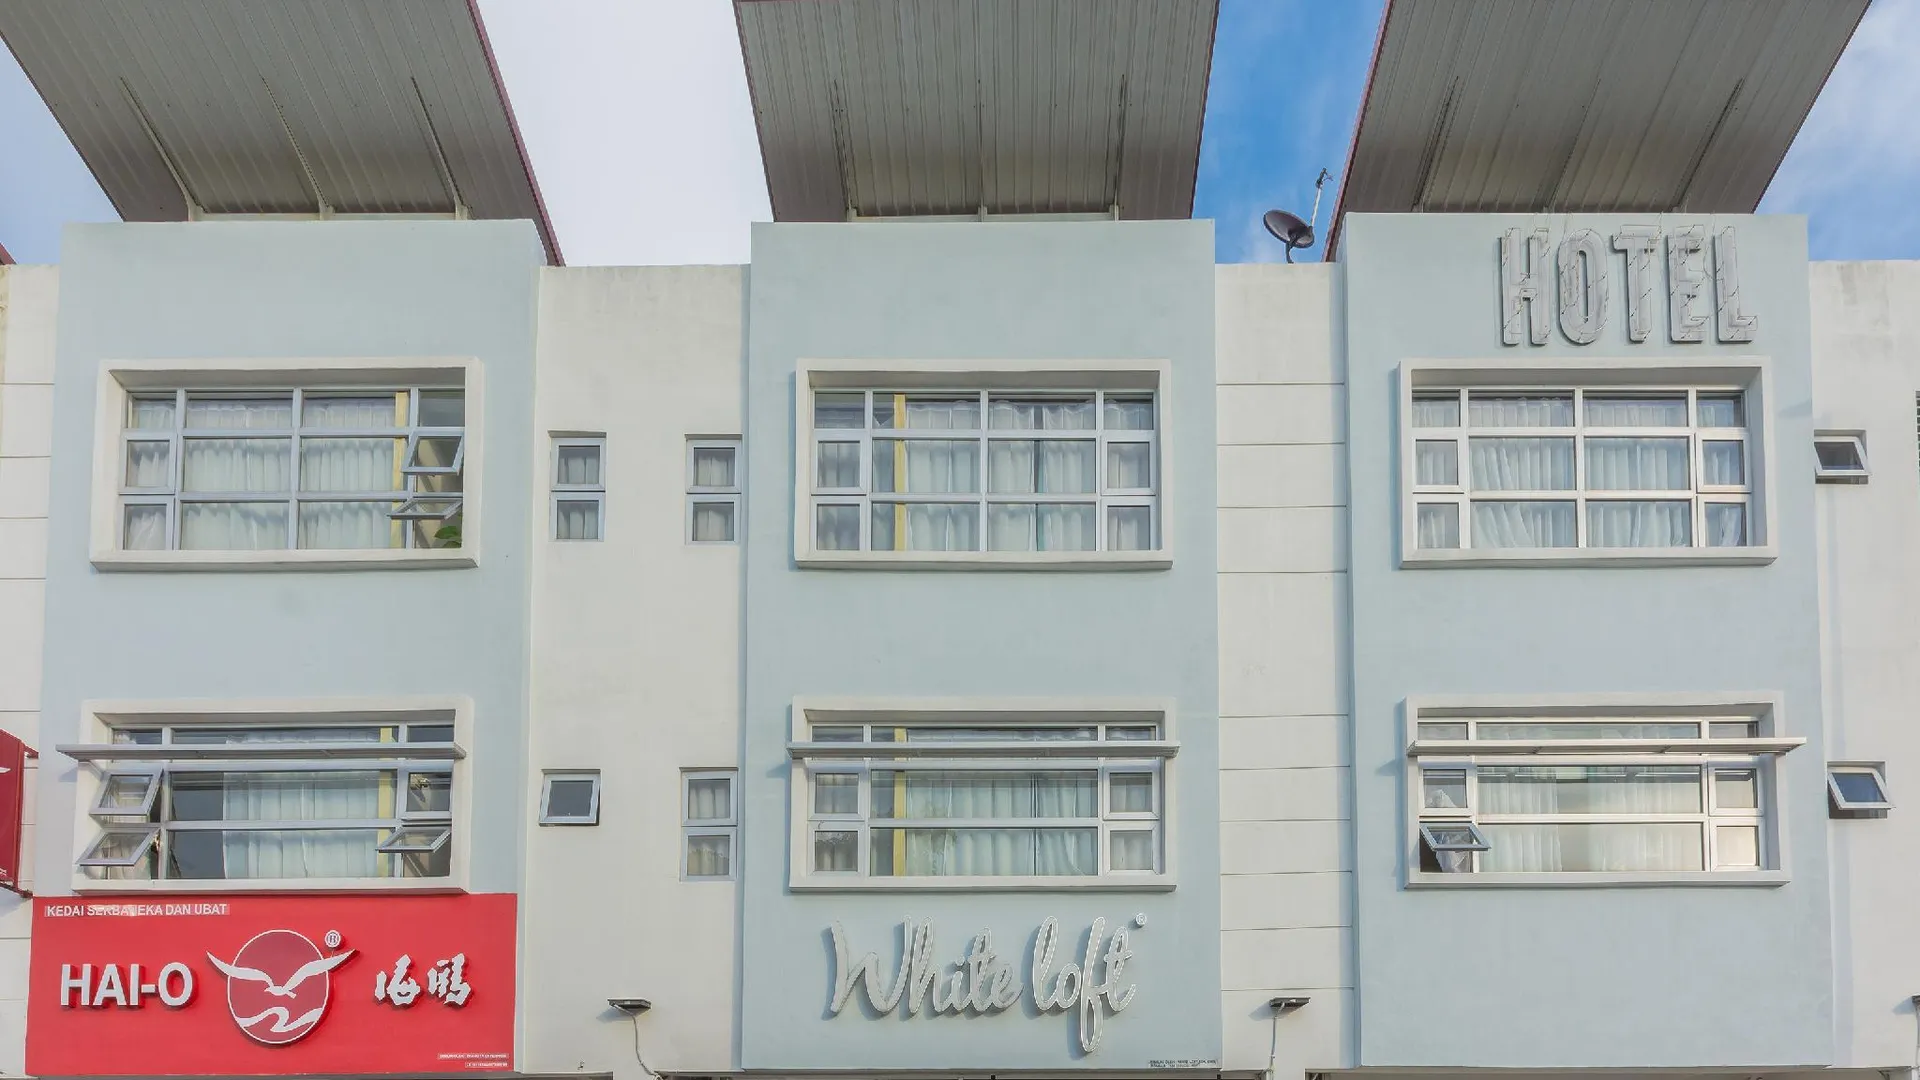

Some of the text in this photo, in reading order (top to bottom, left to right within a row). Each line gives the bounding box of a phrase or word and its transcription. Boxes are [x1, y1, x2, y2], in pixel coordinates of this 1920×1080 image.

[1500, 225, 1758, 345] HOTEL
[46, 905, 84, 917] KEDAI
[165, 904, 191, 916] DAN
[194, 903, 228, 916] UBAT
[60, 962, 193, 1007] HAI-O
[829, 914, 1137, 1053] White loft
